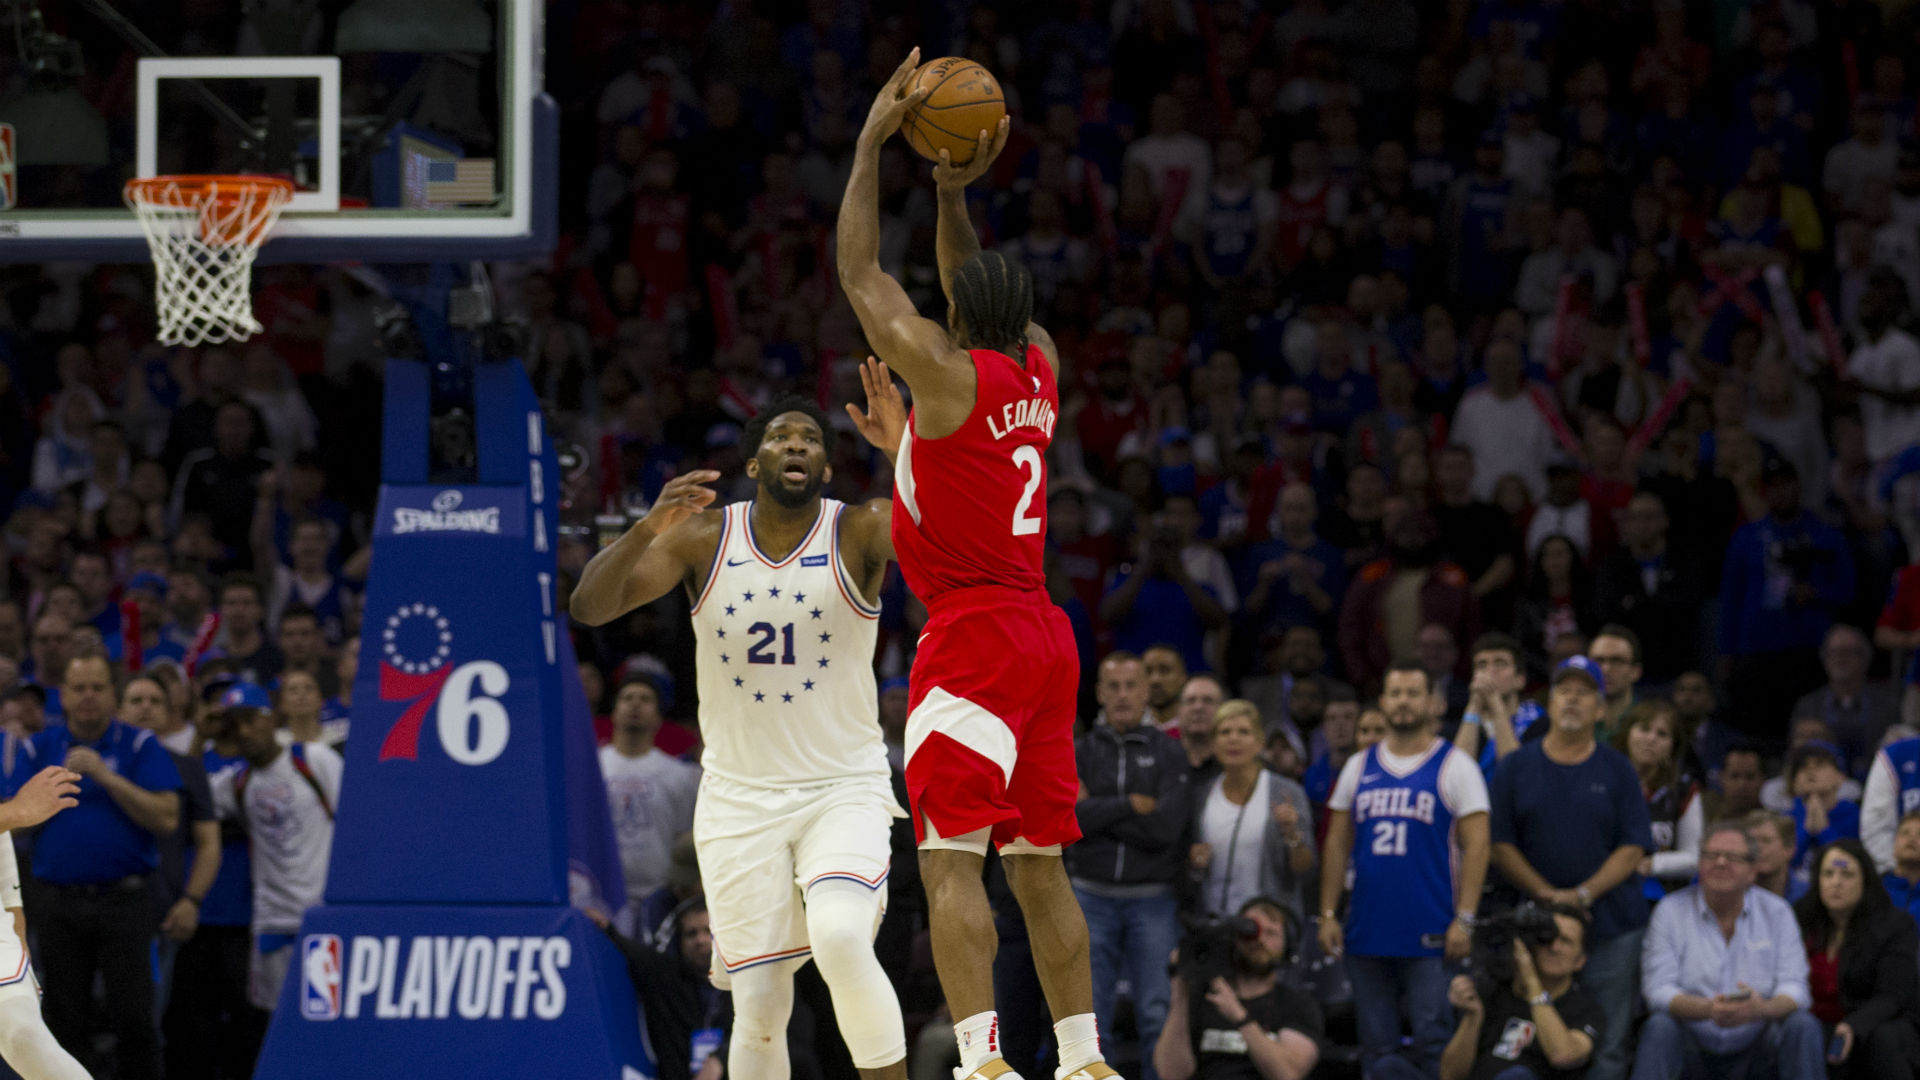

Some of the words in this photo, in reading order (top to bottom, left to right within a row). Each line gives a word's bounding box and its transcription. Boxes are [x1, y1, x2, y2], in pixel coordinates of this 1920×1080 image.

[1012, 445, 1041, 536] 2
[393, 507, 500, 534] SPALDING
[747, 621, 796, 665] 21
[379, 660, 510, 766] 76
[1355, 787, 1436, 825] PHILA
[1372, 820, 1408, 856] 21
[344, 935, 572, 1020] PLAYOFFS
